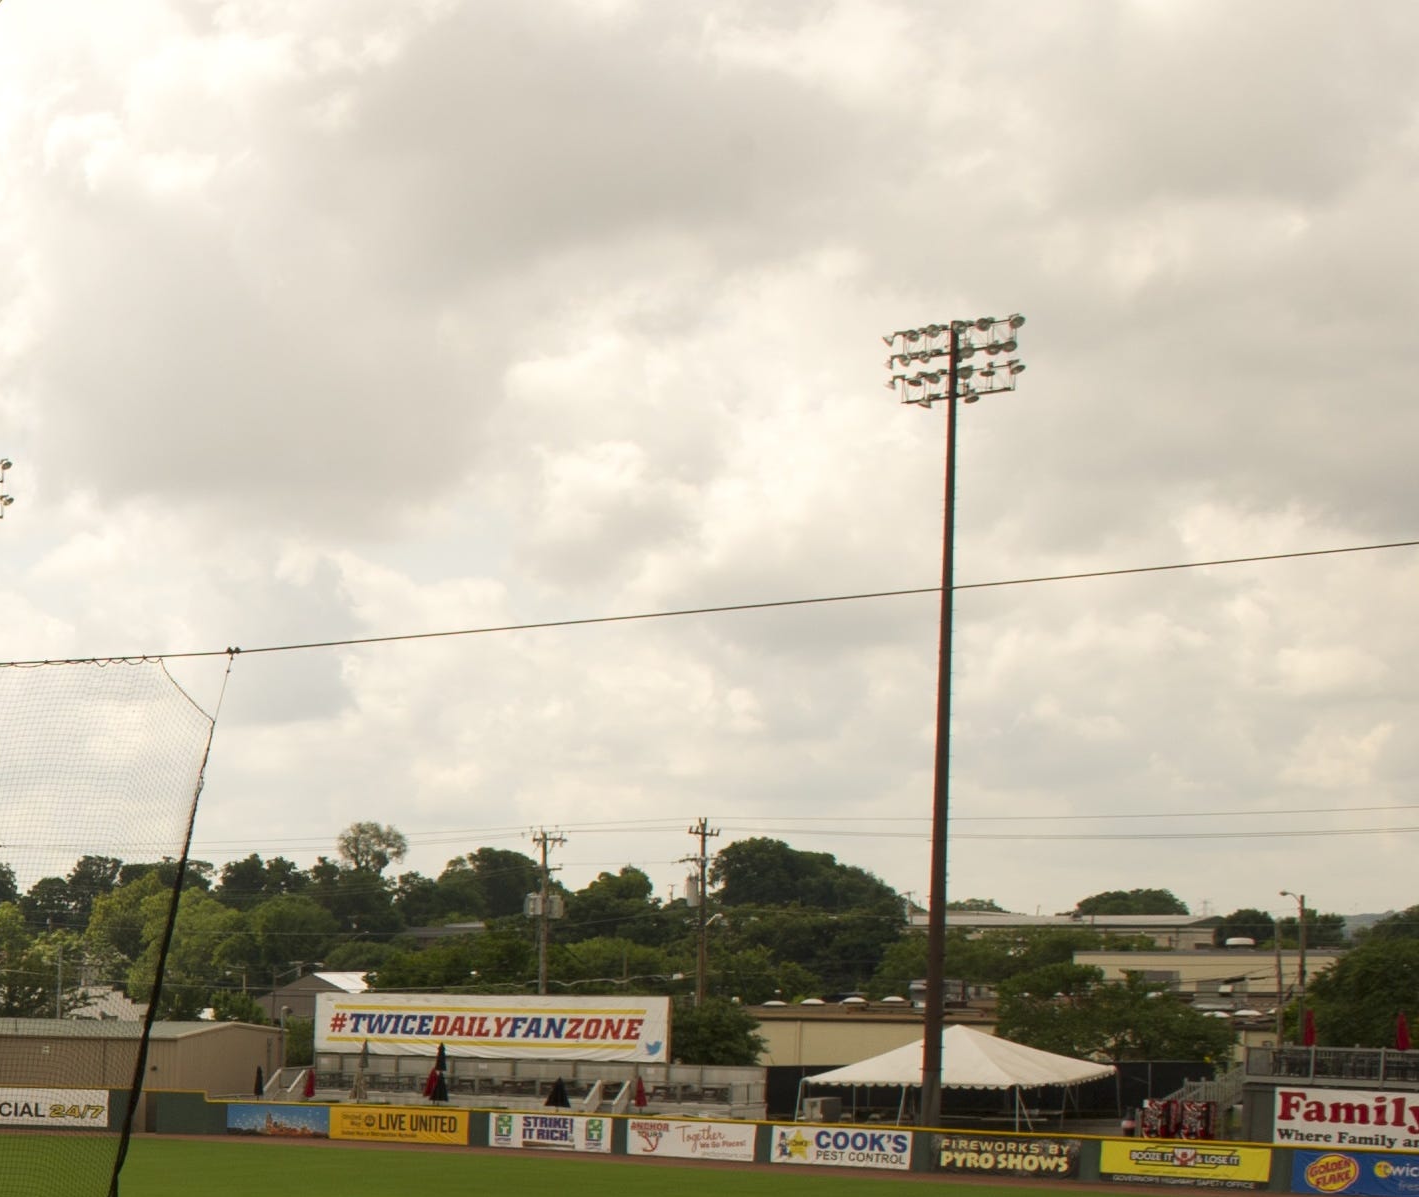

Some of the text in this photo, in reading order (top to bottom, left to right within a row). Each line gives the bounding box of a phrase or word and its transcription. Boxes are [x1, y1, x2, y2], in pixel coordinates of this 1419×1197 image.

[330, 1012, 644, 1040] #TWICEDAILYFANZONE
[49, 1104, 105, 1119] 24/7
[378, 1113, 457, 1133] LIVE UNITED
[630, 1121, 670, 1132] ANCHOR
[523, 1128, 568, 1142] IT RICH
[815, 1130, 908, 1153] COOK'S
[1277, 1128, 1332, 1142] Where
[1337, 1132, 1398, 1149] Family
[940, 1138, 1070, 1155] FIREWORKS BY
[816, 1150, 906, 1165] PEST CONTROL
[940, 1151, 1068, 1172] PYRO SHOWS
[1131, 1151, 1162, 1161] BOOZE
[1164, 1152, 1173, 1161] IT
[1204, 1154, 1228, 1164] LOSE
[1229, 1156, 1239, 1165] IT
[1310, 1159, 1351, 1178] GOLDEN
[1315, 1171, 1352, 1187] FLAKE
